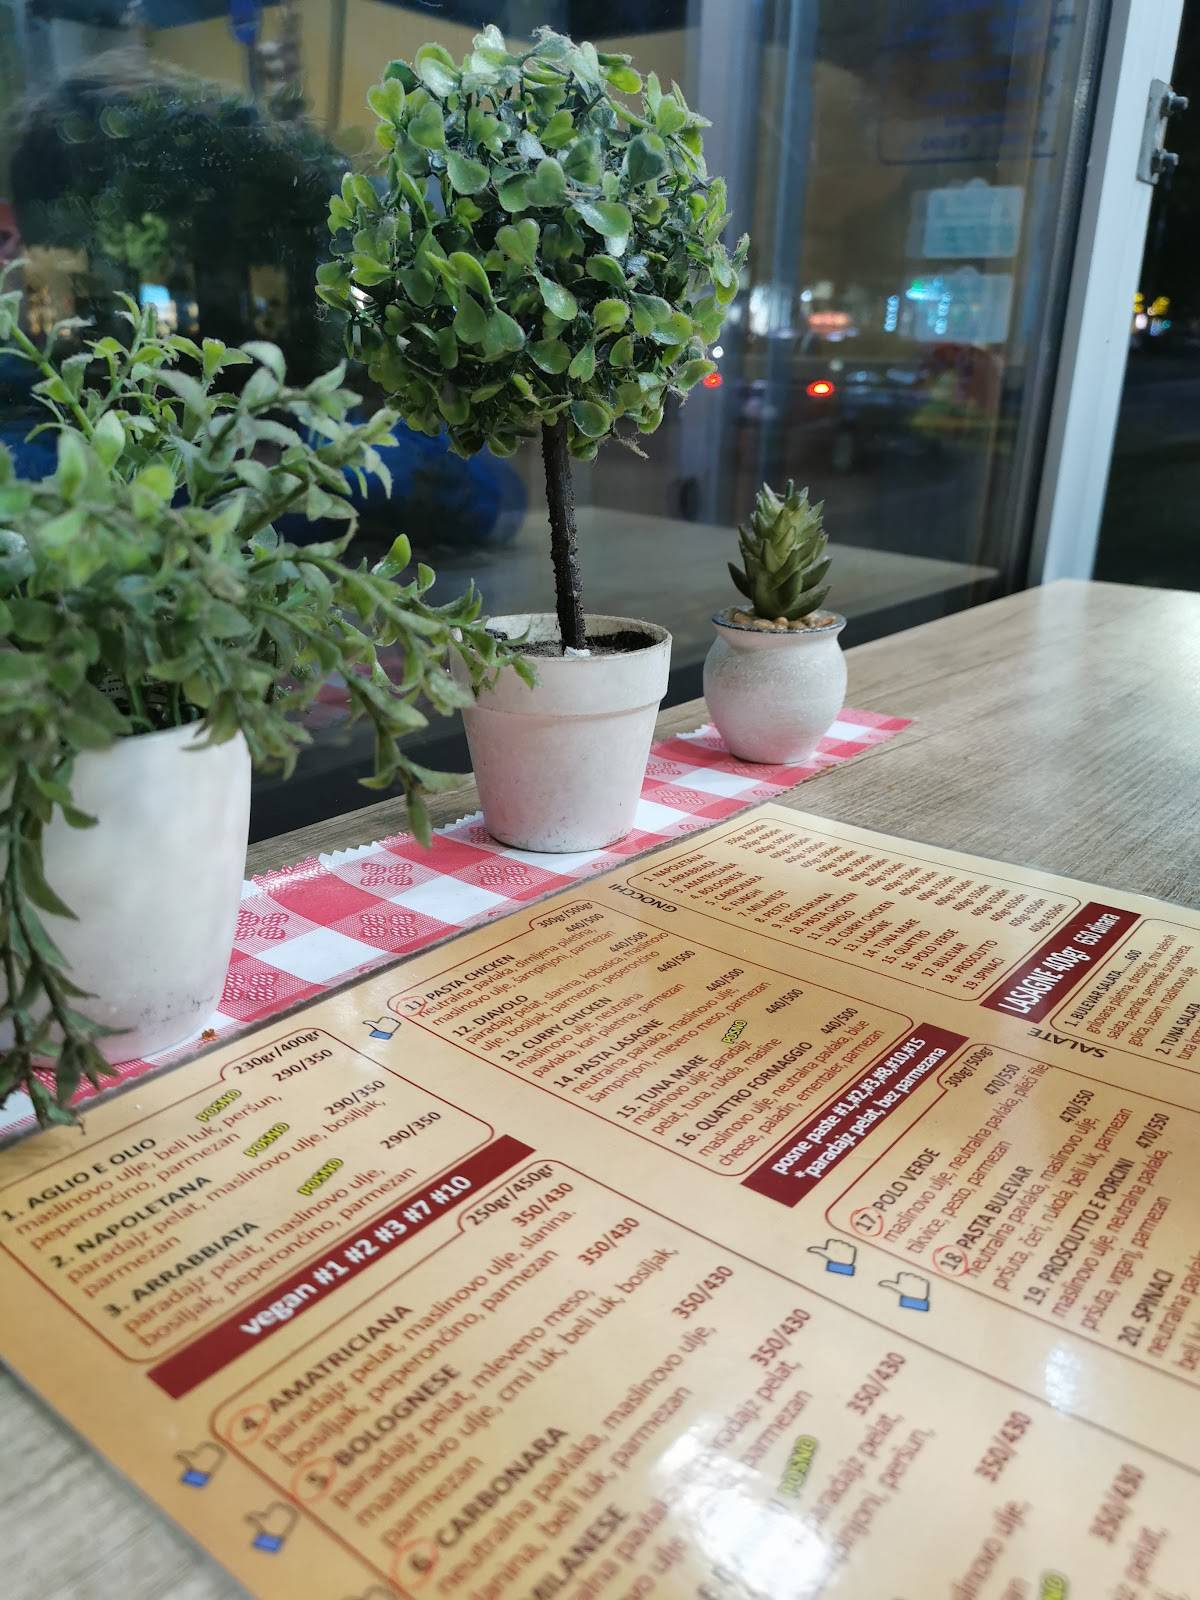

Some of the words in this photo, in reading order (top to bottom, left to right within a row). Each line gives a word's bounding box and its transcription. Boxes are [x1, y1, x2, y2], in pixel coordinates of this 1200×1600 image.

[536, 902, 593, 928] 300gr/500gr
[608, 883, 678, 913] GNOCCHI
[564, 913, 604, 934] 440/500
[609, 931, 648, 952] 440/500
[1084, 913, 1120, 934] dinara
[425, 980, 467, 1000] PASTA
[464, 954, 515, 981] CHICKEN
[656, 950, 696, 972] 440/500
[705, 968, 744, 992] 440/500
[997, 967, 1064, 1014] LASAGNE
[1041, 945, 1091, 972] 400gr
[472, 995, 528, 1026] DIAVOLO
[521, 1023, 564, 1049] CURRY
[562, 996, 612, 1026] CHICKEN
[765, 988, 804, 1014] 440/500
[820, 1007, 858, 1034] 440/500
[233, 1027, 320, 1074] 230gr/400gr
[573, 1051, 615, 1075] PASTA
[609, 1018, 664, 1052] LASAGNE
[721, 1019, 747, 1044] POSNO
[1027, 1027, 1109, 1058] SALATE
[272, 1049, 333, 1082] 290/350
[634, 1079, 676, 1103] TUNA
[669, 1054, 709, 1080] MARE
[695, 1088, 752, 1131] QUATTRO
[746, 1041, 813, 1090] FORMAGGIO
[944, 1043, 994, 1088] 300gr/500gr
[983, 1064, 1021, 1095] 470/550
[196, 1090, 240, 1124] POSNO
[324, 1080, 385, 1115] 290/350
[771, 1140, 813, 1175] posne
[805, 1115, 842, 1144] paste
[831, 1037, 926, 1116] #1,#2,#3,#8,#10,#15
[848, 1108, 886, 1136] pelat,
[872, 1090, 902, 1108] bez
[894, 1047, 947, 1094] parmezana
[1058, 1089, 1095, 1123] 470/550
[244, 1122, 288, 1158] POSNO
[380, 1111, 441, 1150] 290/350
[1135, 1112, 1170, 1149] 470/550
[28, 1172, 90, 1210] AGLIO
[92, 1163, 106, 1174] E
[109, 1138, 156, 1165] OLIO
[298, 1159, 343, 1197] POSNO
[465, 1160, 553, 1226] 250gr/450gr
[871, 1181, 908, 1212] POLO
[899, 1147, 941, 1181] VERDE
[1093, 1157, 1135, 1202] PORCINI
[75, 1176, 212, 1254] NAPOLETANA
[511, 1182, 574, 1227] 350/430
[956, 1214, 996, 1250] PASTA
[984, 1166, 1034, 1214] BULEVAR
[1088, 1199, 1106, 1210] E
[132, 1222, 259, 1302] ARRABBIATA
[240, 1283, 318, 1335] vegan
[312, 1260, 349, 1285] #1
[344, 1238, 380, 1264] #2
[373, 1219, 407, 1243] #3
[402, 1199, 432, 1223] #7
[429, 1176, 472, 1204] #10
[577, 1217, 640, 1266] 350/430
[1037, 1209, 1100, 1284] PROSCIUTTO
[671, 1265, 734, 1319] 350/430
[268, 1306, 413, 1413] AMATRICIANA
[749, 1308, 811, 1367] 350/430
[846, 1352, 906, 1416] 350/430
[331, 1364, 460, 1468] BOLOGNESE
[434, 1427, 568, 1549] CARBONARA
